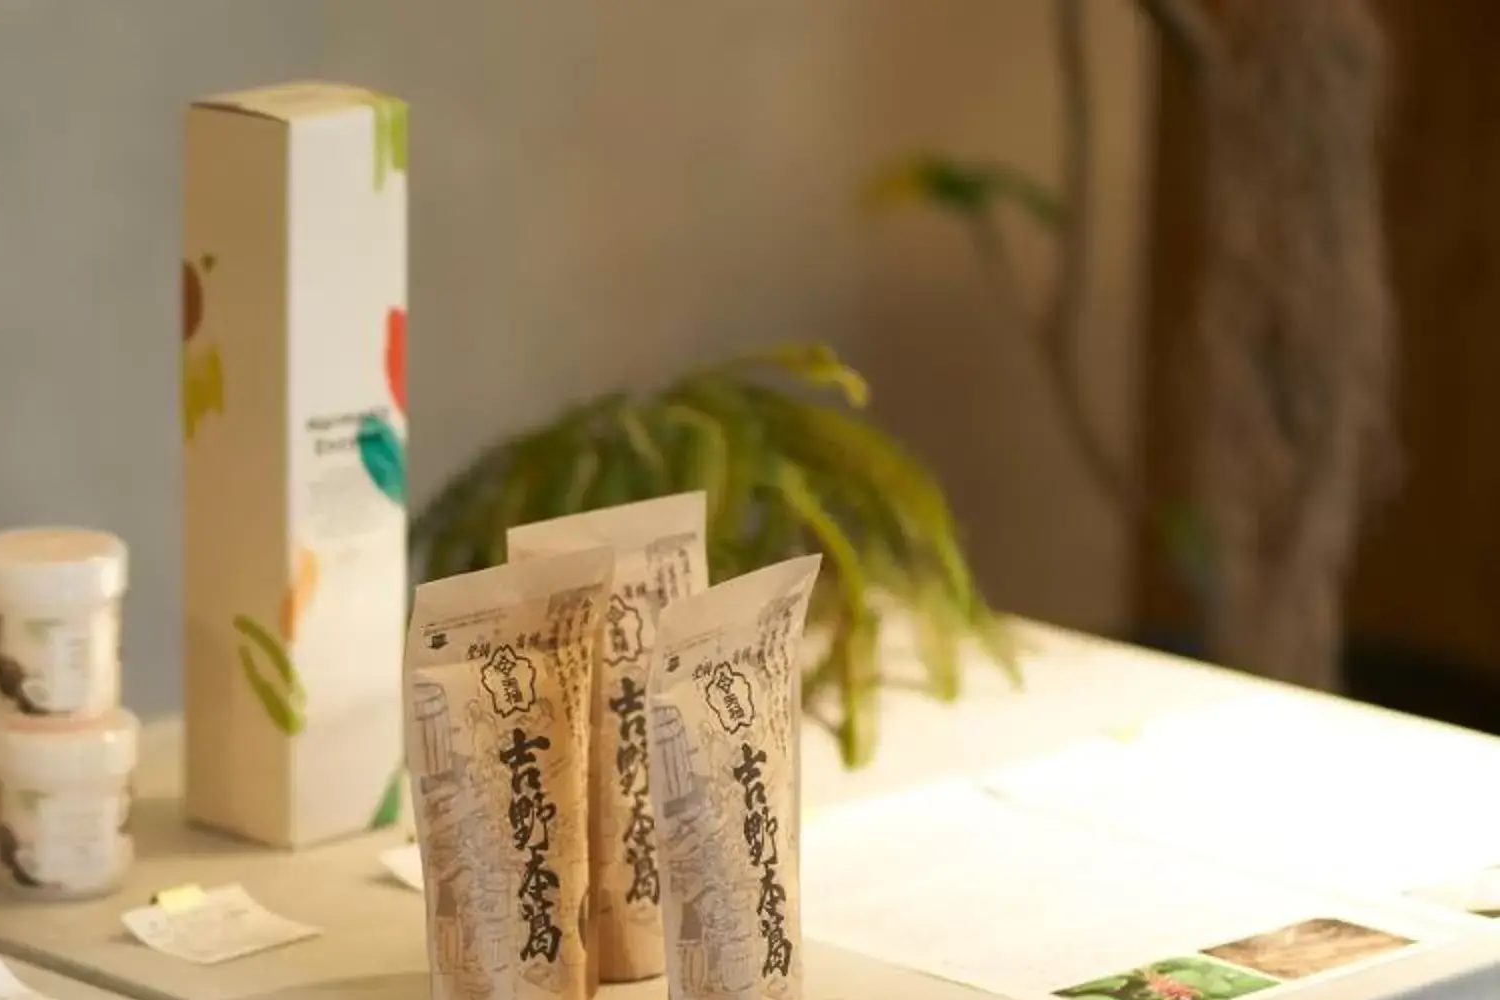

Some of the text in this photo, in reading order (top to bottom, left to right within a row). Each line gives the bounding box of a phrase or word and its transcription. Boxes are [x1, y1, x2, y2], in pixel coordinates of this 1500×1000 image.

[499, 727, 563, 963] 吉野本葛
[733, 742, 793, 978] 吉野本葛
